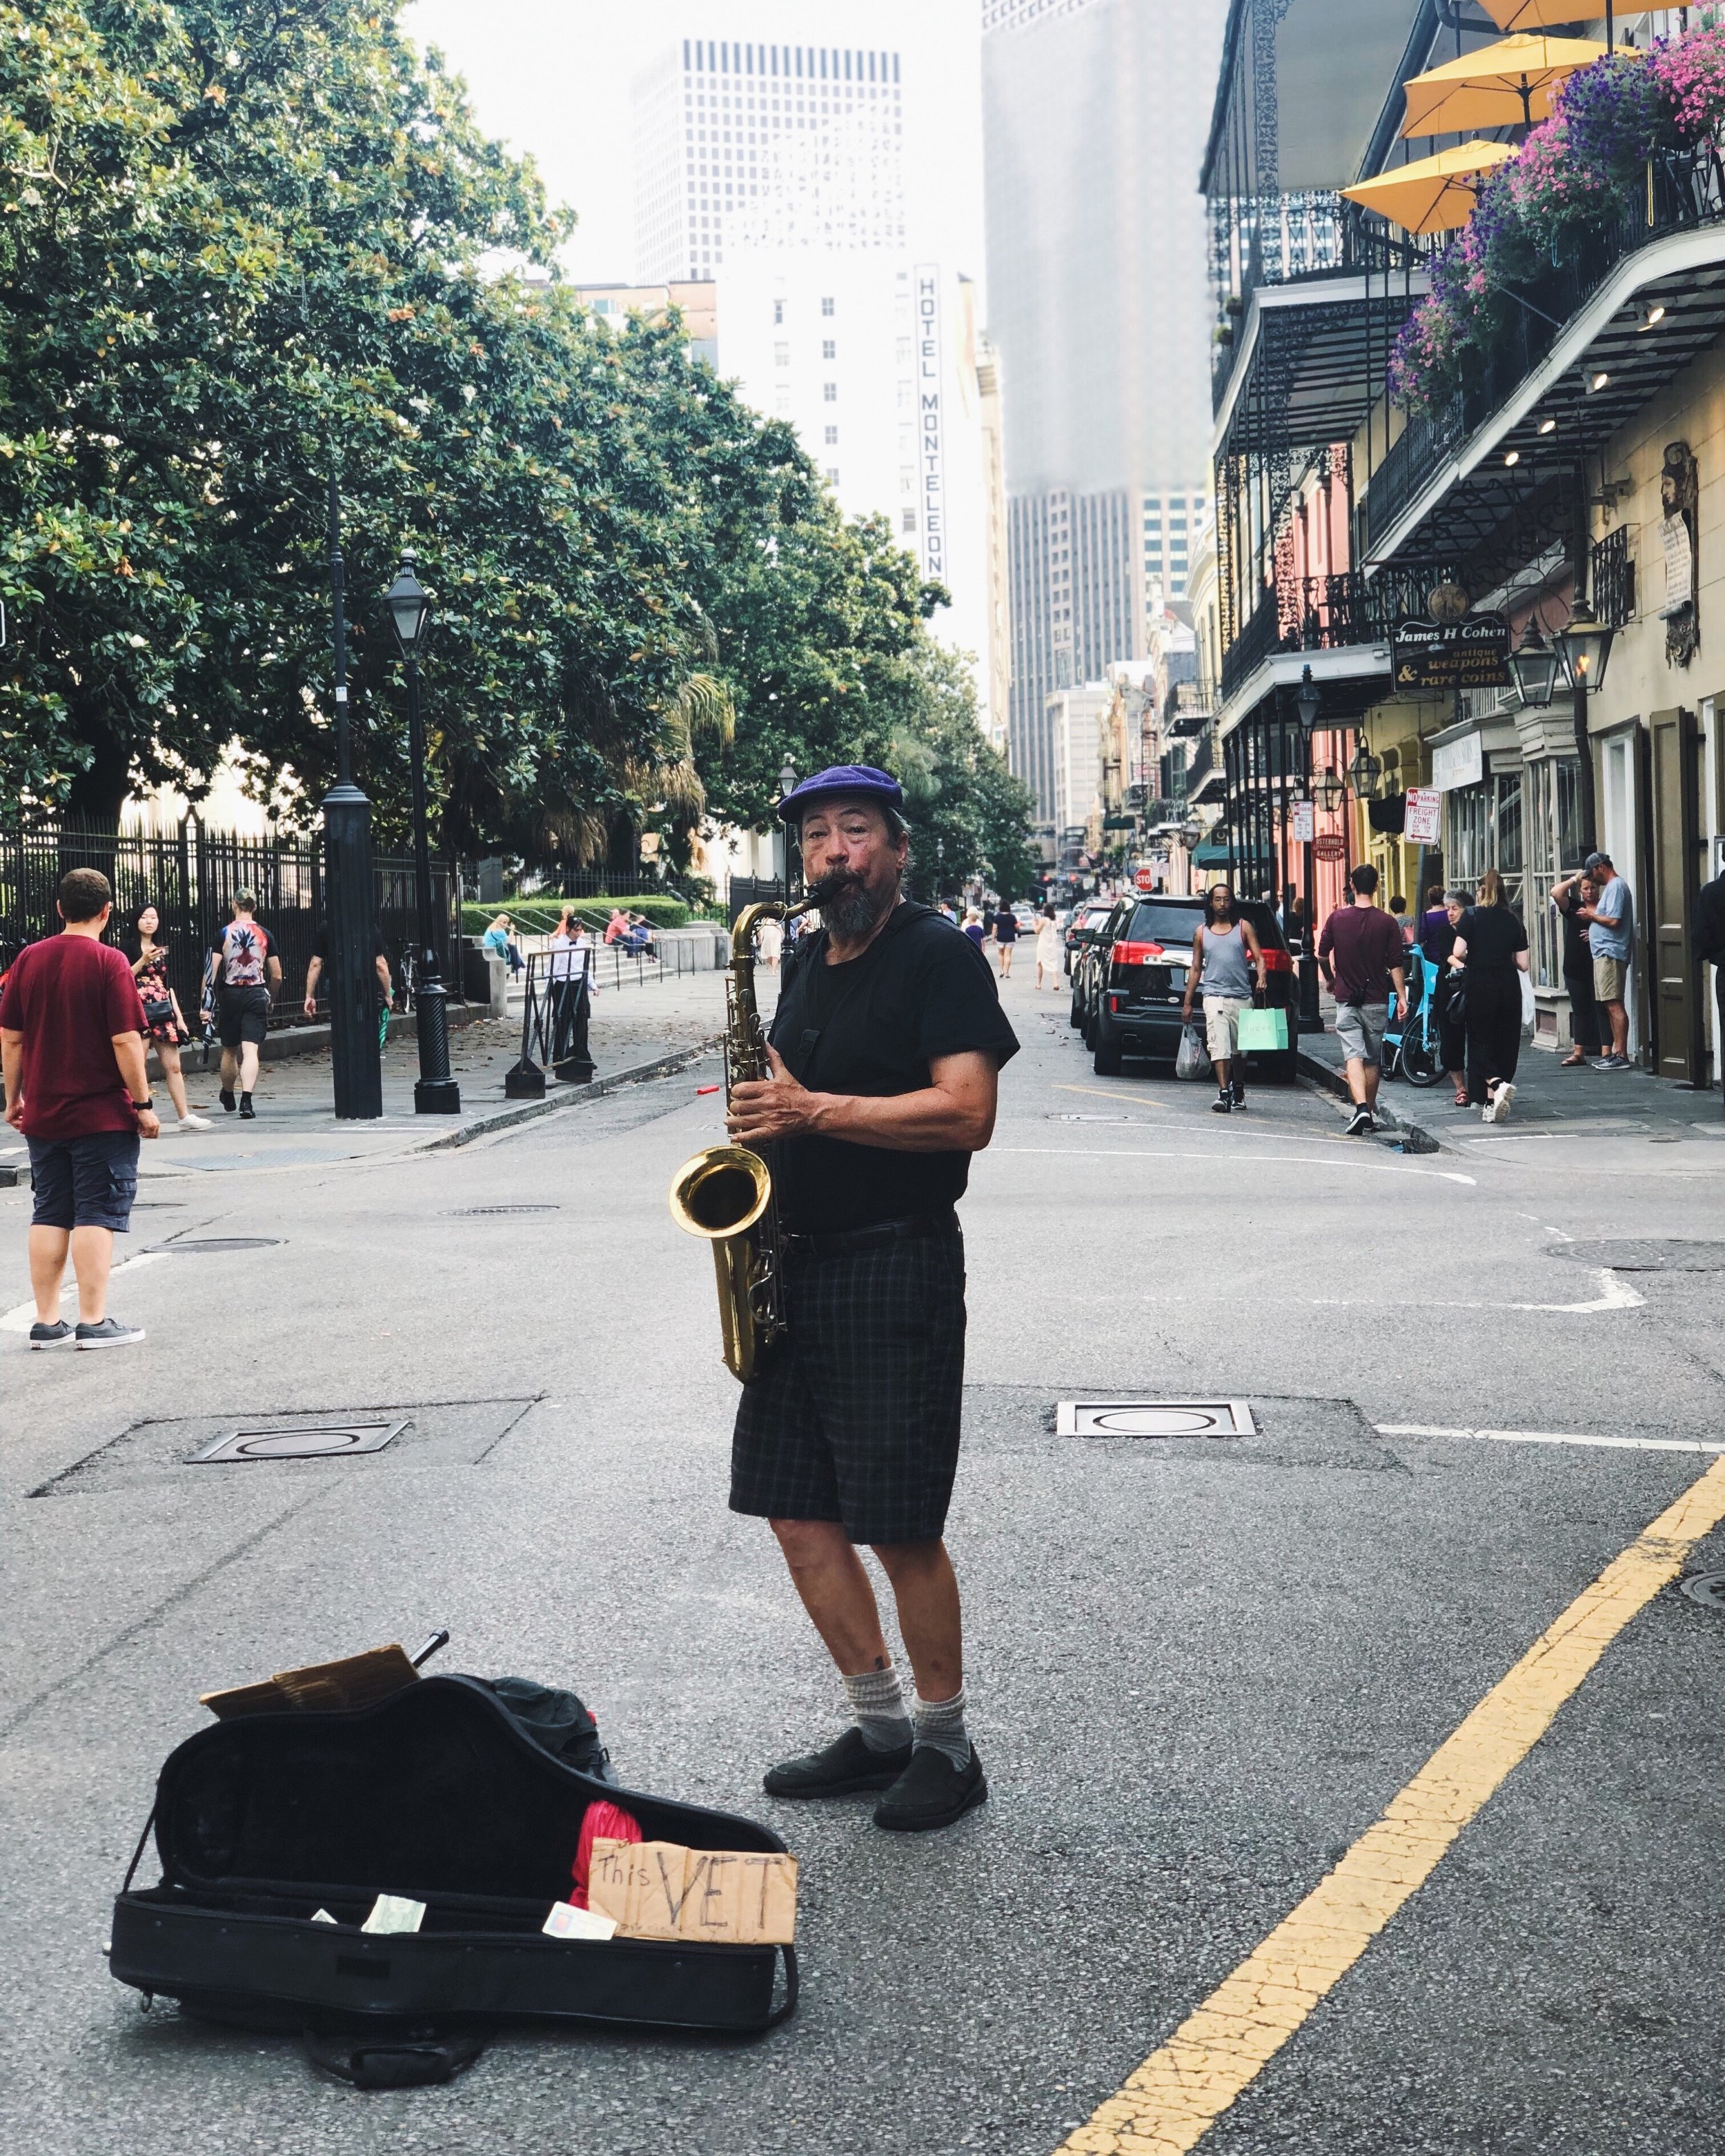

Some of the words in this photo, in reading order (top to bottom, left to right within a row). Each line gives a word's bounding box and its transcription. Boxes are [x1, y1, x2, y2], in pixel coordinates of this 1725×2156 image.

[920, 278, 936, 377] HOTEL
[922, 394, 943, 580] MONTELEON
[1395, 630, 1440, 642] James
[1443, 627, 1459, 640] H
[1461, 626, 1506, 639] Cohen
[1452, 648, 1497, 658] antique
[1428, 656, 1499, 671] weapons
[1398, 664, 1418, 682] &
[1420, 674, 1457, 686] rare
[1461, 669, 1506, 684] coins
[1408, 792, 1417, 803] NO
[1417, 794, 1440, 804] PARKING
[1409, 807, 1437, 817] FREIGHT
[1413, 816, 1431, 824] ZONE
[1136, 875, 1150, 884] STO
[598, 1854, 651, 1886] This
[656, 1851, 787, 1930] VET
